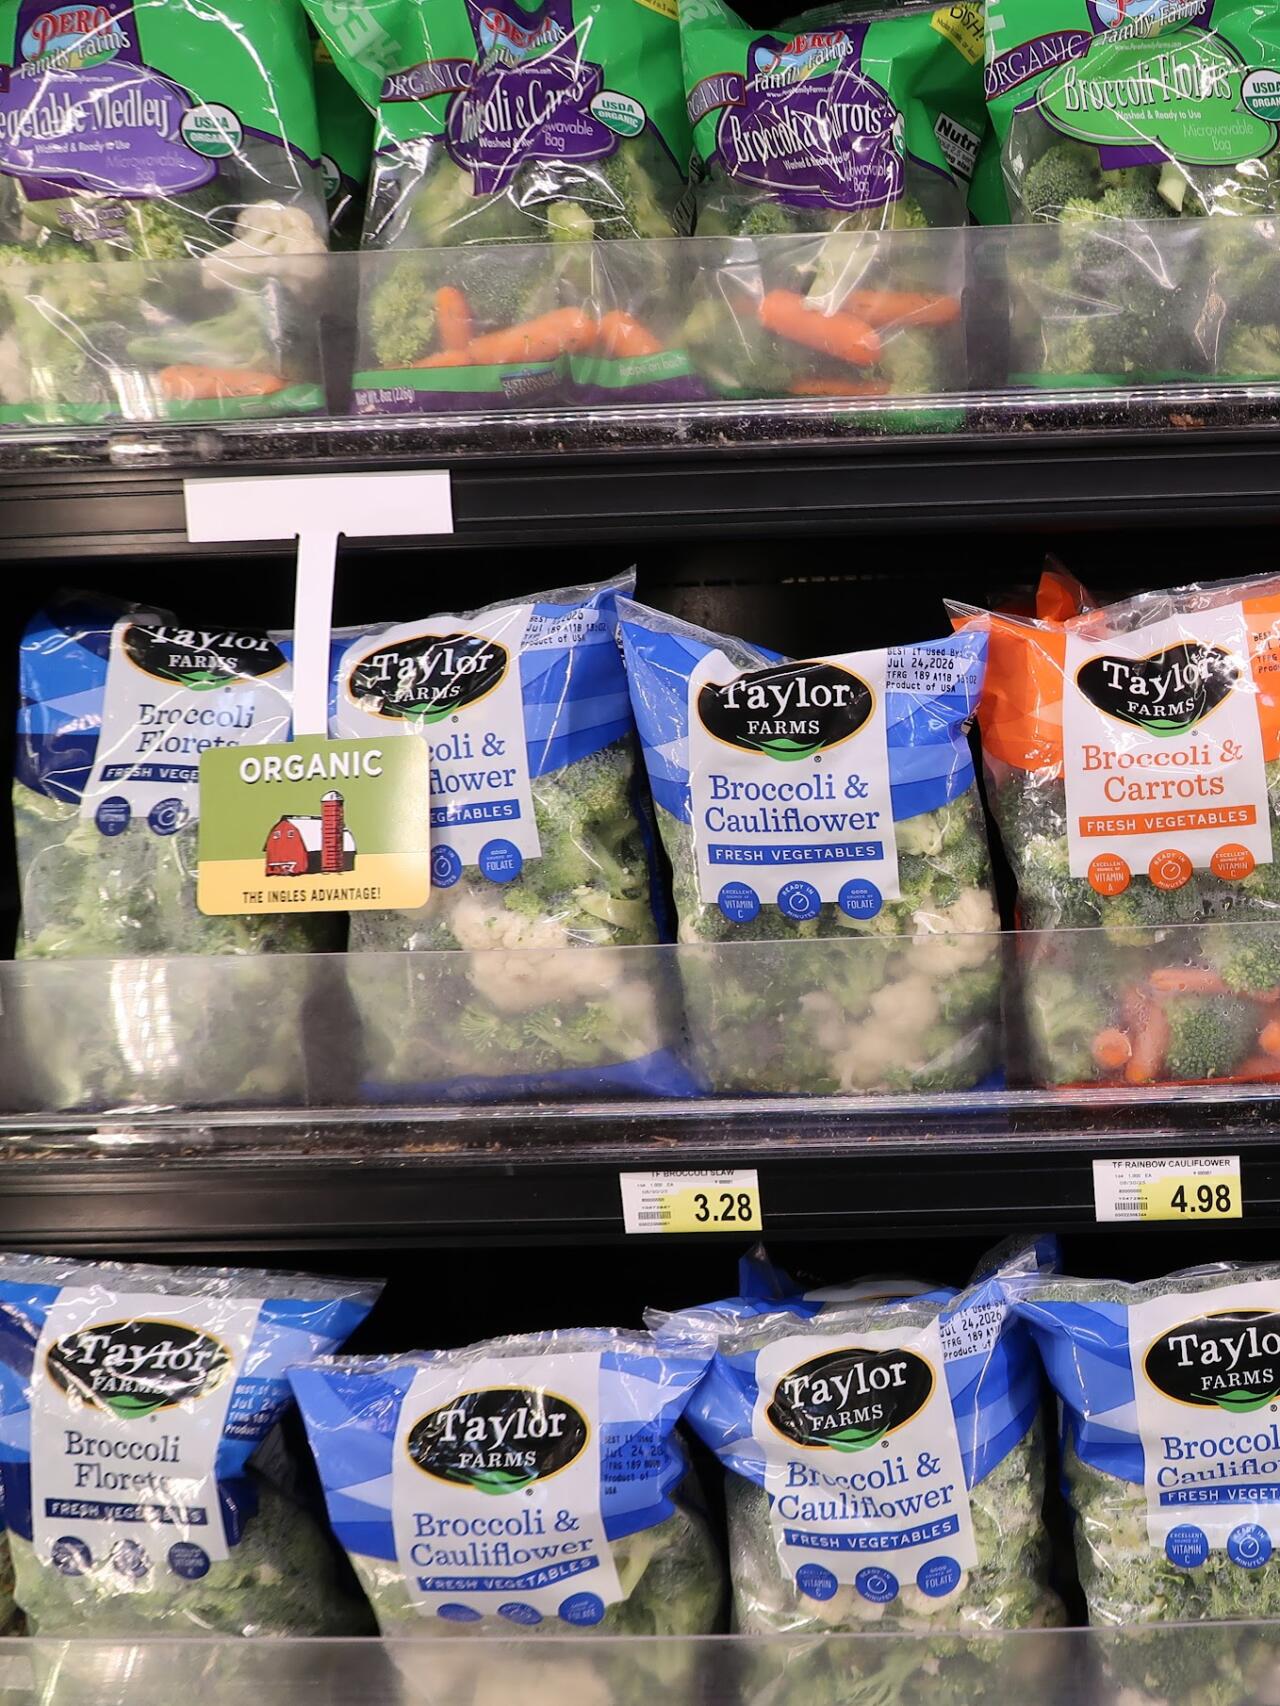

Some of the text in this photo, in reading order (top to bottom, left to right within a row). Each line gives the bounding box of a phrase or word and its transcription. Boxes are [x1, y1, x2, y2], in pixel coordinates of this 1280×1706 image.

[983, 34, 1086, 94] ORGANIC
[1065, 63, 1150, 111] Broccoli
[602, 100, 636, 113] USDA
[1155, 111, 1185, 121] Ready to
[1183, 119, 1253, 138] Microwavable
[545, 133, 565, 151] Bag
[1212, 136, 1232, 154] Bag
[372, 648, 494, 684] Taylor
[888, 658, 954, 669] Jul 24,2026
[886, 681, 920, 689] Product
[926, 683, 935, 691] of
[721, 677, 851, 718] Taylor
[1128, 698, 1195, 716] FARMS
[138, 704, 254, 729] Broccoli
[747, 720, 820, 736] FARMS
[1082, 739, 1243, 771] Broccoli &
[240, 750, 383, 784] ORGANIC
[708, 774, 868, 801] Broccoli &
[1104, 775, 1225, 803] Carrots
[705, 806, 880, 833] Cauliflower
[1087, 810, 1248, 832] FRESH VEGETABLES
[715, 845, 875, 862] FRESH VEGETABLES
[1218, 862, 1248, 871] VITAMIN
[1095, 873, 1123, 882] VITAMIN
[243, 887, 381, 903] THE INGLES ADVANTAGE!
[725, 900, 753, 909] VITAMIN
[847, 900, 873, 909] FOLATE
[738, 910, 743, 918] C
[1168, 1159, 1230, 1167] CAULIFLOWER
[694, 1193, 752, 1222] 3.28
[1171, 1184, 1231, 1212] 4.98
[968, 1331, 982, 1341] 189
[944, 1345, 977, 1359] Product
[785, 1358, 908, 1411] Taylor
[1201, 1368, 1274, 1391] FARMS
[811, 1403, 883, 1432] FARMS
[436, 1409, 567, 1450] Taylor
[64, 1430, 180, 1463] Broccoli
[458, 1451, 537, 1469] FARMS
[785, 1452, 941, 1489] Broccoli &
[777, 1484, 954, 1522] Cauliflower
[1168, 1489, 1219, 1501] FRESH
[413, 1509, 579, 1538] Broccoli &
[791, 1521, 952, 1548] FRESH VEGETABLES
[410, 1538, 593, 1568] Cauliflower
[1172, 1545, 1201, 1554] VITAMIN
[1185, 1555, 1190, 1563] C
[424, 1558, 591, 1591] FRESH VEGETABLES
[925, 1575, 954, 1588] FOLATE
